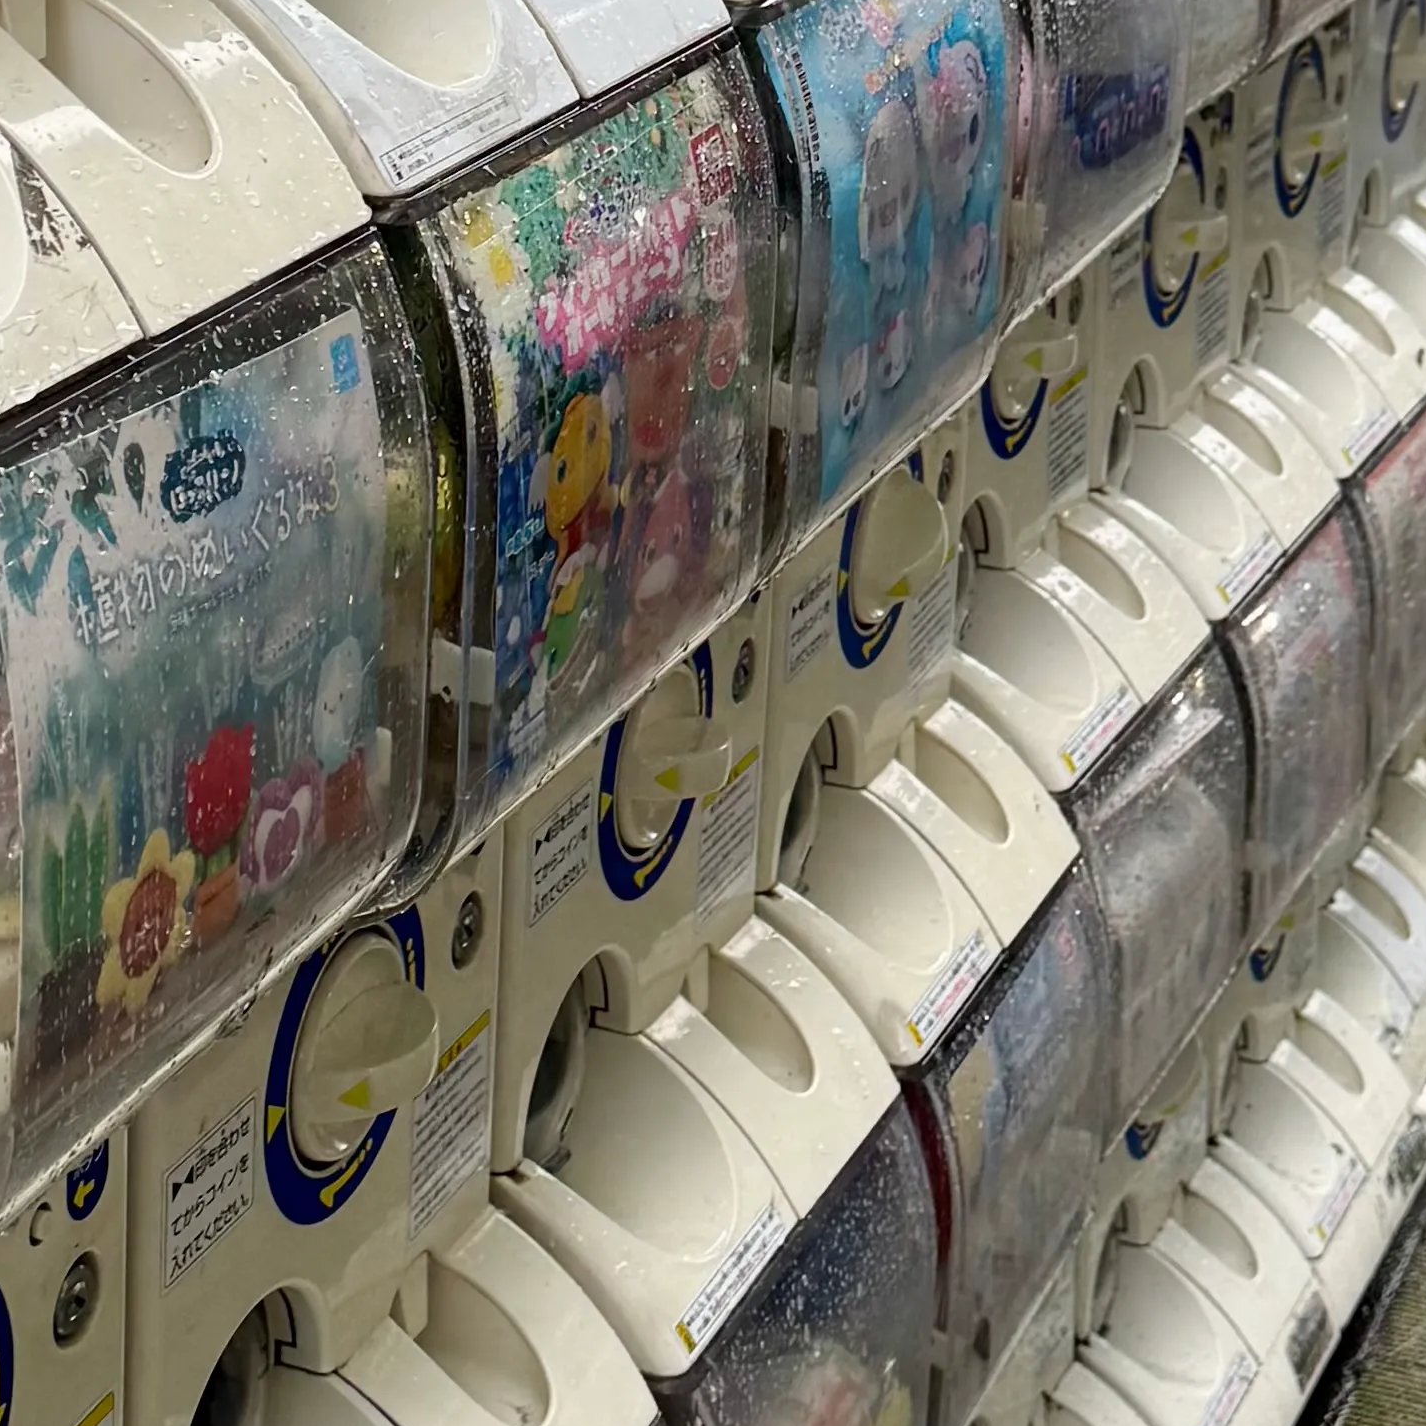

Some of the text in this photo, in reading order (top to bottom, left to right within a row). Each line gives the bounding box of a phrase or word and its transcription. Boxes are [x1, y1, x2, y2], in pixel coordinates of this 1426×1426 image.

[195, 1116, 251, 1180] 印を合わせ
[171, 1152, 250, 1237] てからコインを
